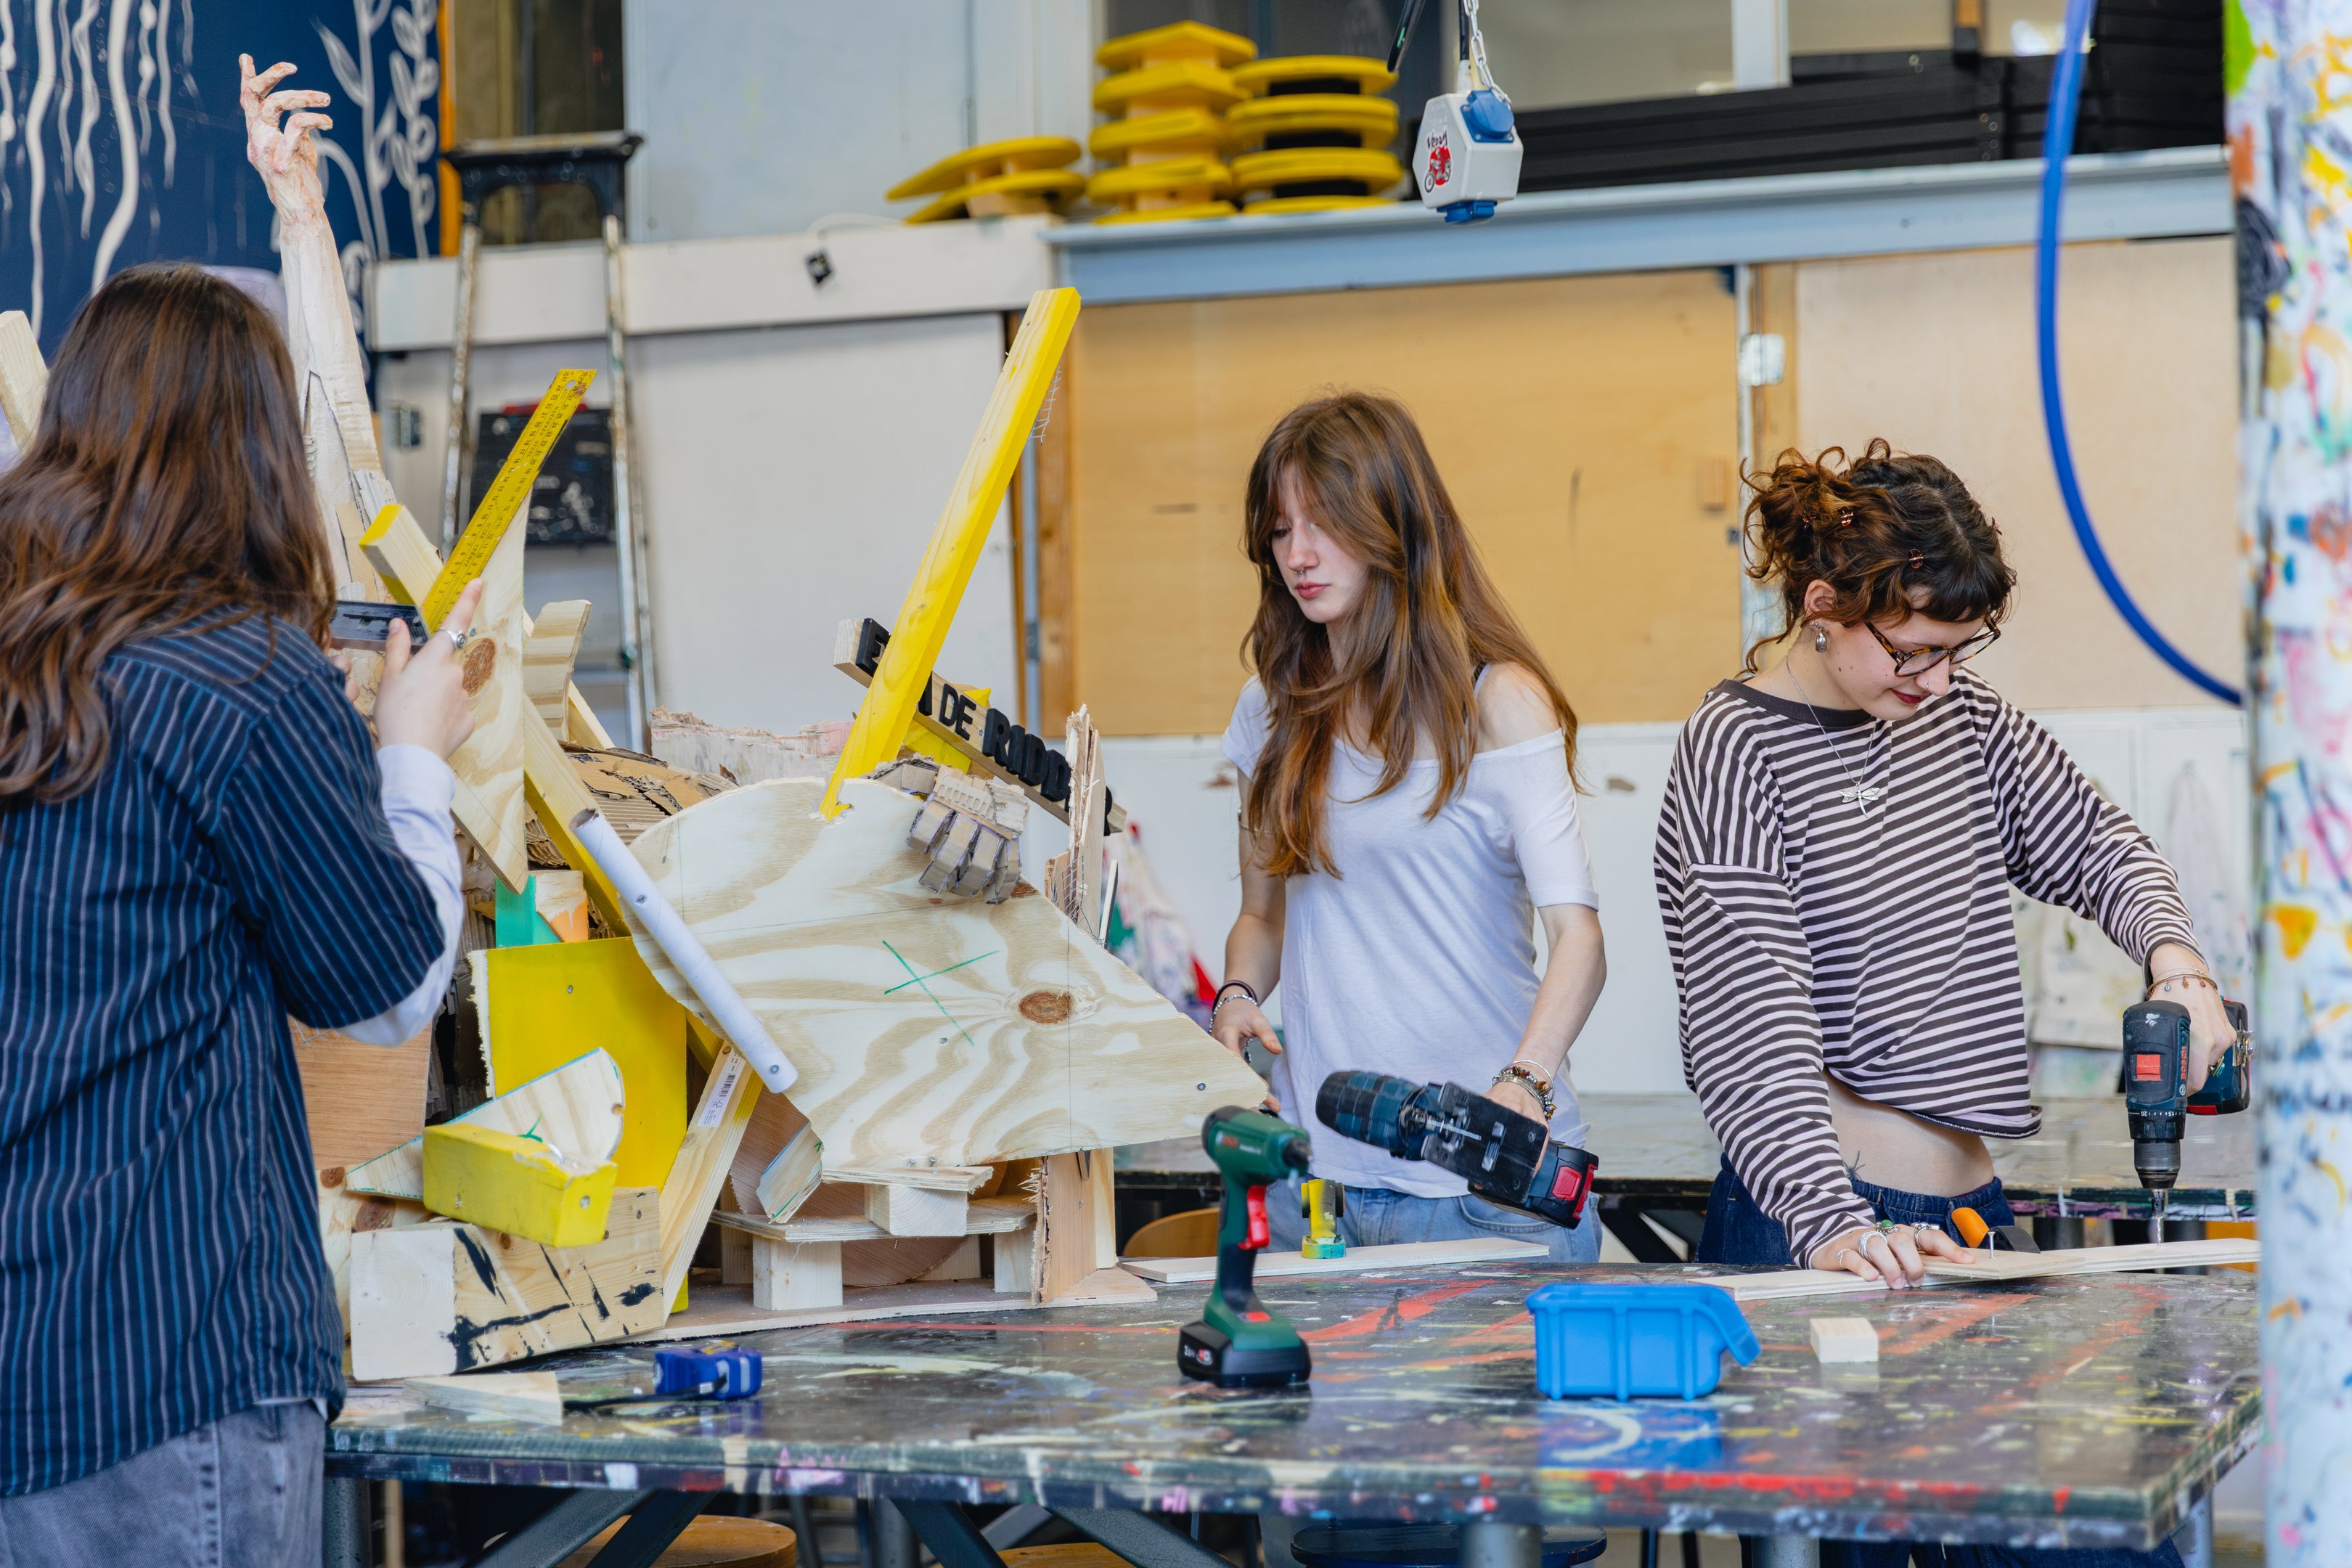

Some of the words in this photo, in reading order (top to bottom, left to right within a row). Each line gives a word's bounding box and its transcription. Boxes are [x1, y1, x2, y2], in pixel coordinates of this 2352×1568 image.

[539, 406, 559, 436] HARDENED
[526, 440, 539, 458] STEEL
[939, 683, 977, 741] DE
